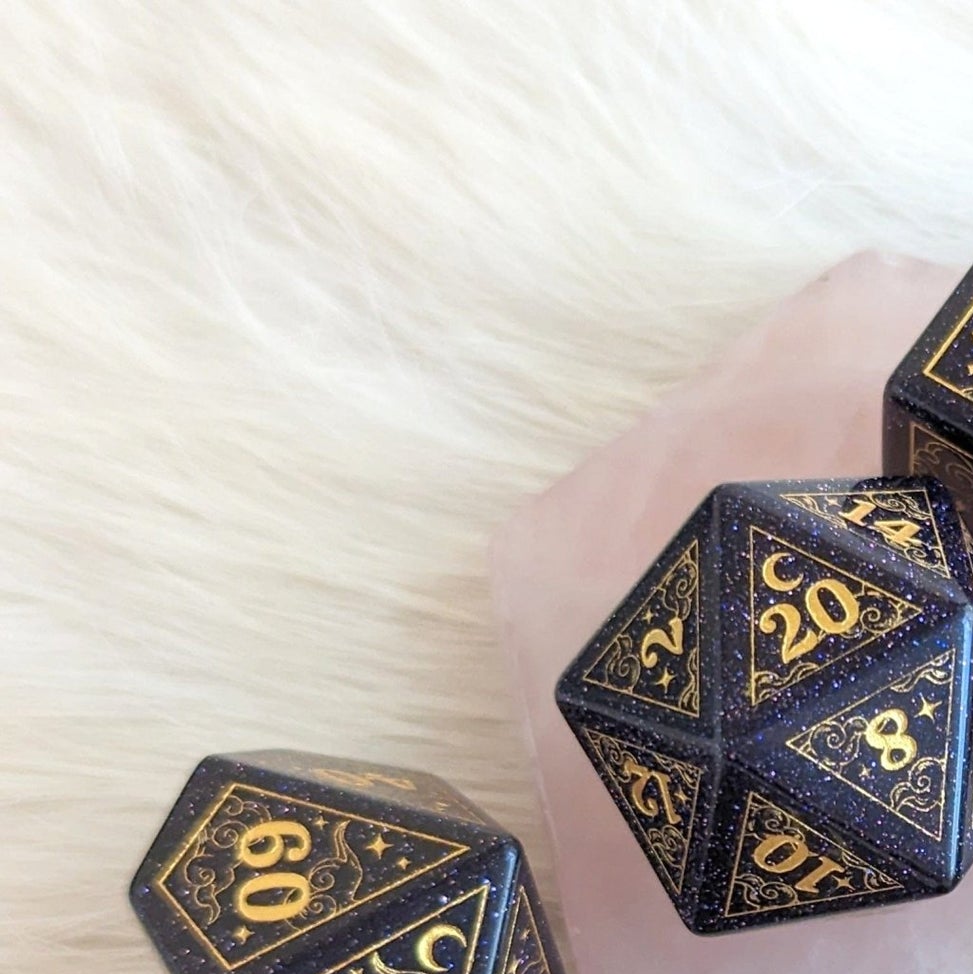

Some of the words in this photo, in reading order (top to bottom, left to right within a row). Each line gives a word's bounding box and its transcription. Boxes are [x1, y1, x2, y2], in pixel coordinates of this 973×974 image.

[839, 500, 922, 547] 14
[642, 617, 683, 668] 2
[760, 578, 860, 664] 20
[865, 707, 917, 771] 8
[238, 820, 313, 923] 60
[753, 832, 846, 894] 10
